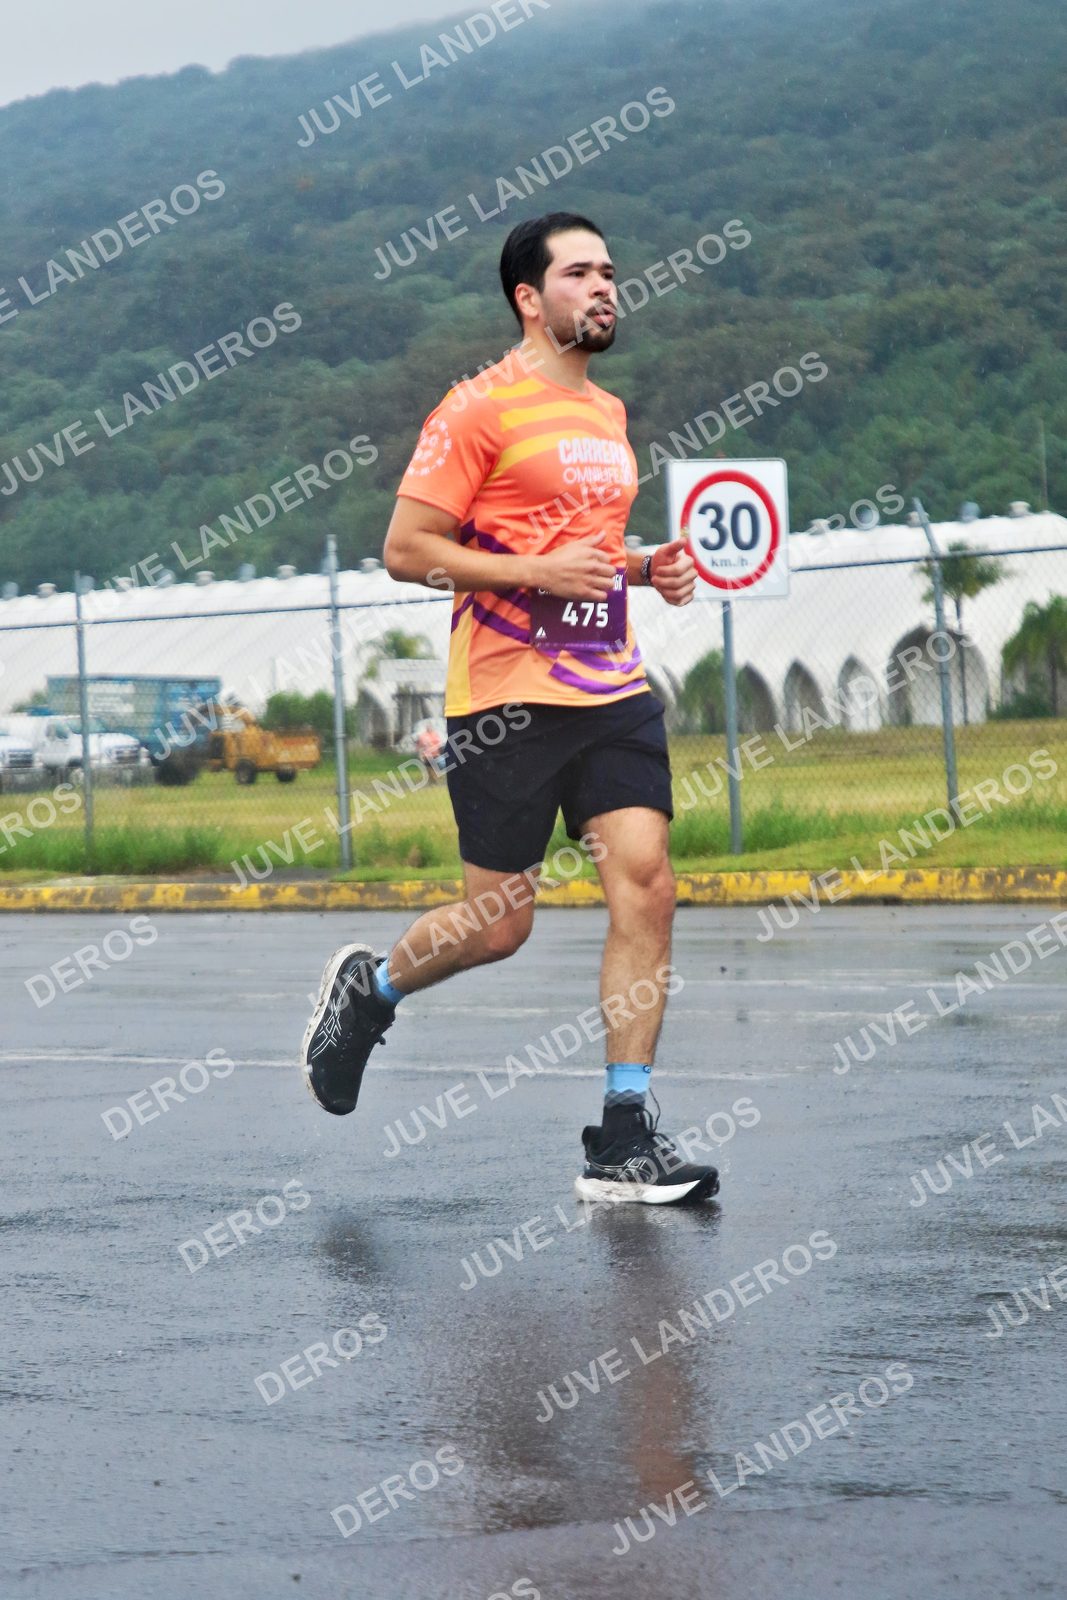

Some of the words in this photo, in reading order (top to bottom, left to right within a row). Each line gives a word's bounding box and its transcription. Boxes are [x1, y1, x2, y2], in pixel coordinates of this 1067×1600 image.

[558, 437, 630, 466] CARRERA
[698, 501, 760, 551] 30
[561, 602, 609, 628] 475
